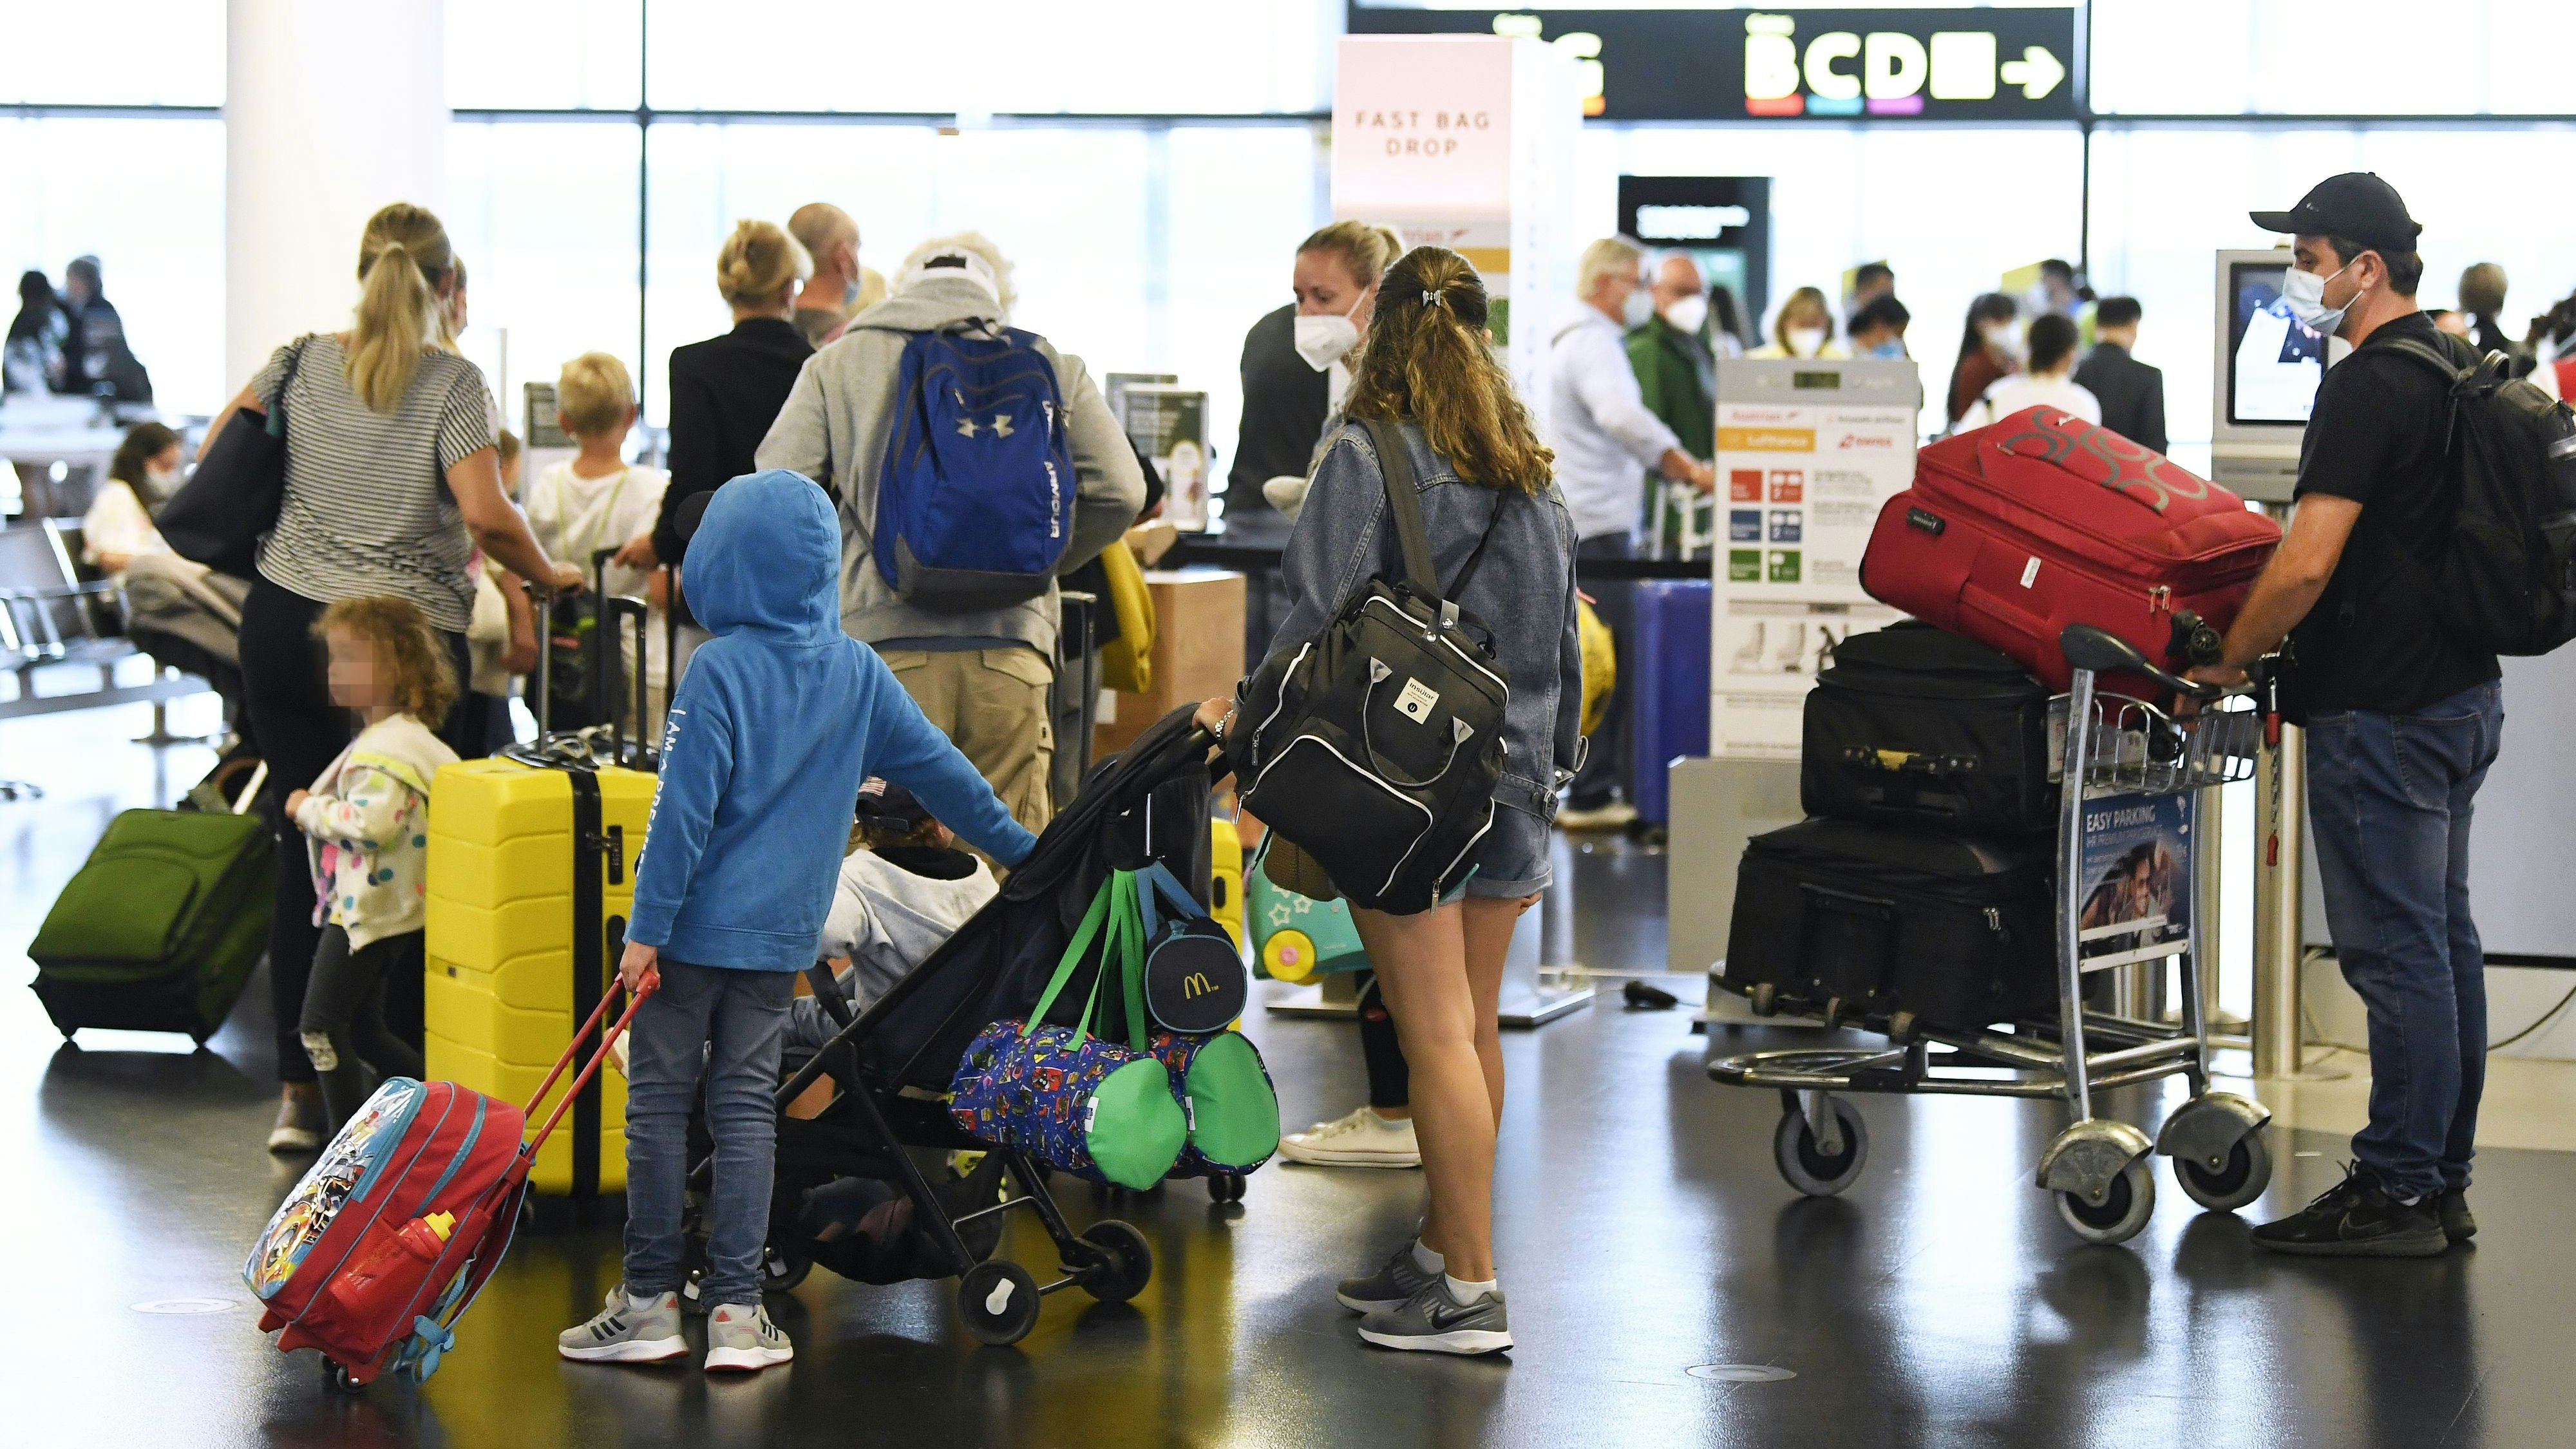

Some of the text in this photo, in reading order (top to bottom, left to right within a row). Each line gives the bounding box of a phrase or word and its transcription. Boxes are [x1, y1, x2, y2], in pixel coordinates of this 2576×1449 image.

[1355, 110, 1490, 129] FAST BAG
[1386, 137, 1458, 156] DROP
[1044, 461, 1060, 538] ARMOUR
[665, 721, 681, 752] AM
[2087, 805, 2156, 833] EASY PARKING
